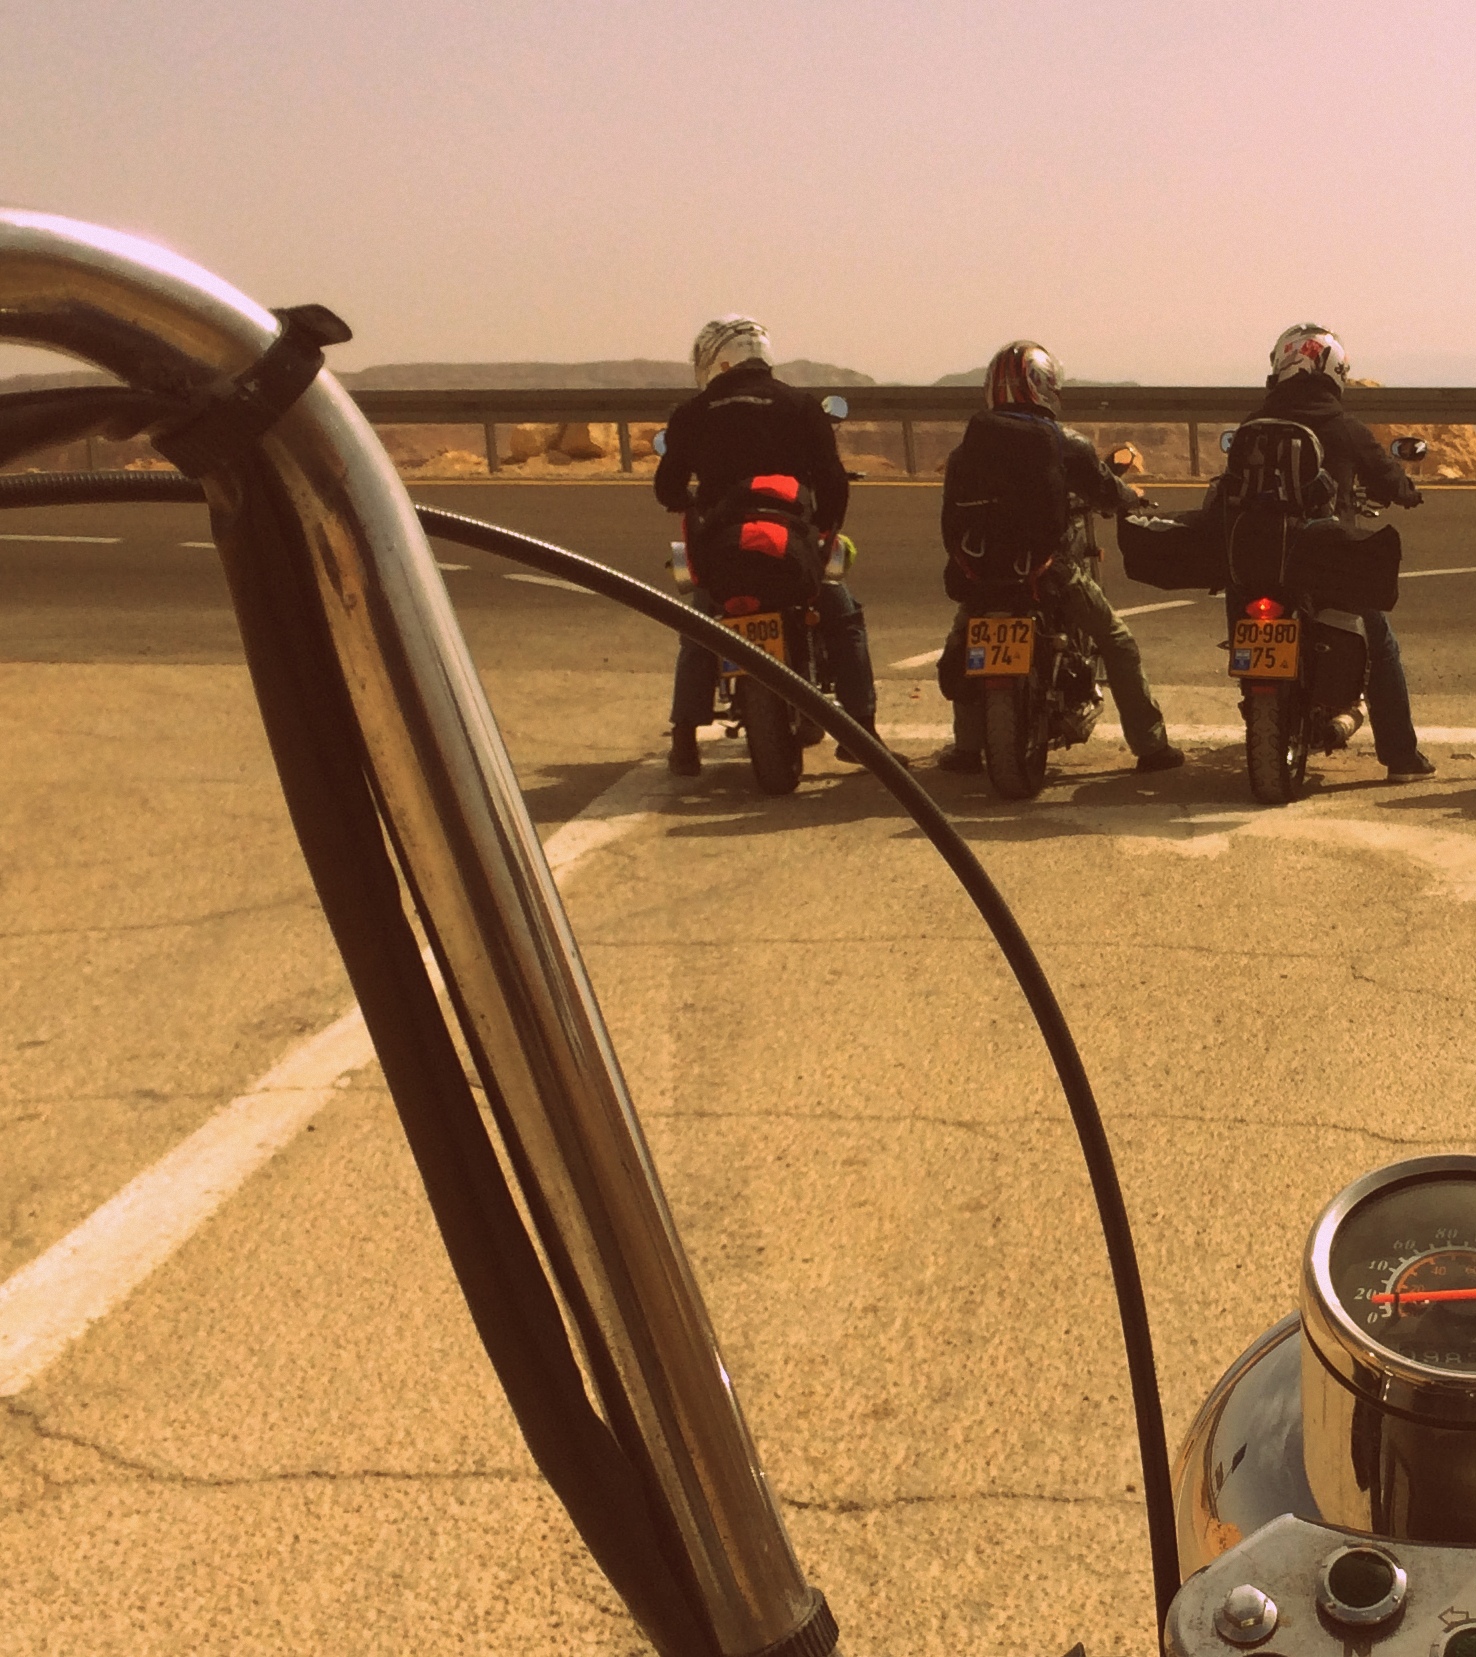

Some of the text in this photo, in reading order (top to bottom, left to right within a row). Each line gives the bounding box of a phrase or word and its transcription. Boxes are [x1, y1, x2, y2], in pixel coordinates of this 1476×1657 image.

[991, 645, 1012, 665] 74
[1252, 646, 1276, 669] 75
[1435, 1227, 1459, 1239] 80
[1393, 1239, 1416, 1250] 60
[1354, 1287, 1377, 1301] 20
[1367, 1311, 1378, 1324] 0
